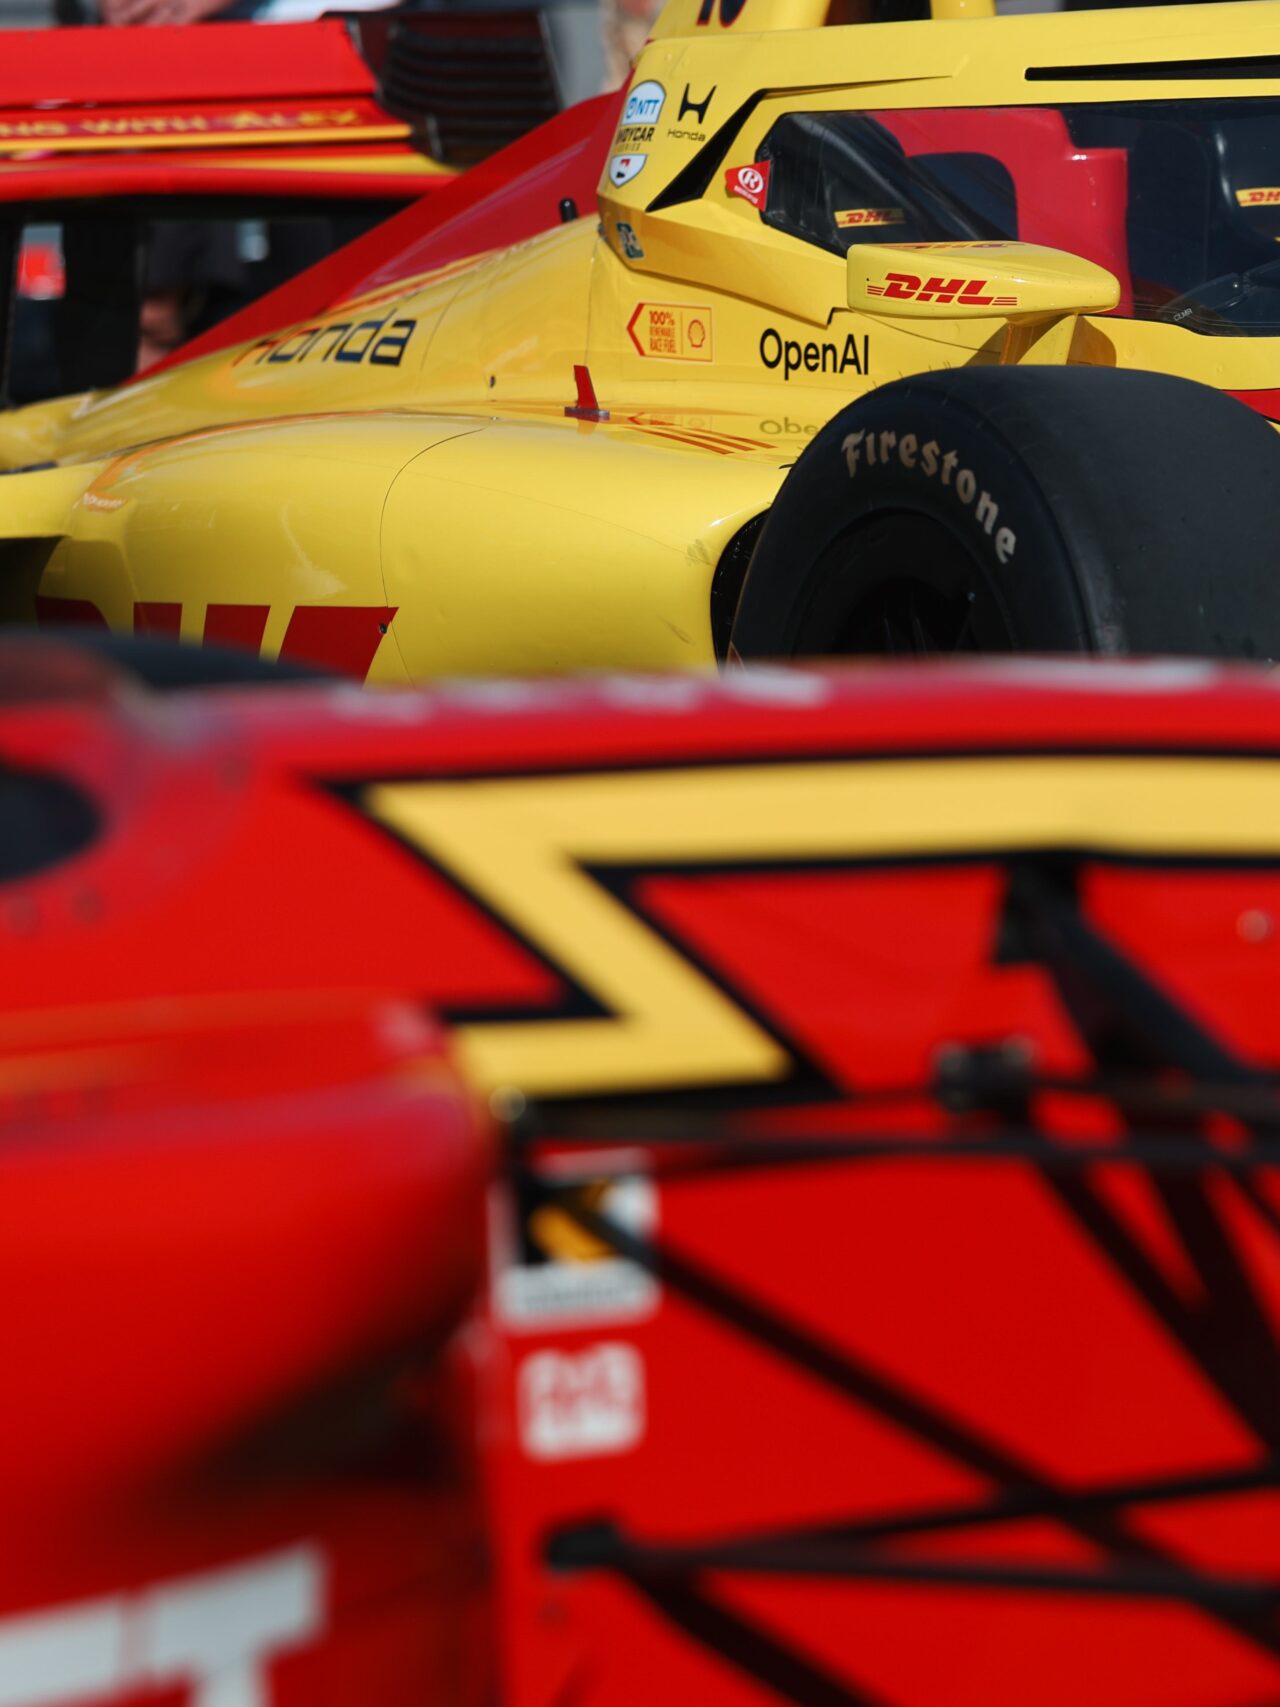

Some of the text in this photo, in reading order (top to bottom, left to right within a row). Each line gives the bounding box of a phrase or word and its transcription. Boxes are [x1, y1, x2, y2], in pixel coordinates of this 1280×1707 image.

[637, 98, 660, 115] NTT
[79, 116, 207, 134] WITH
[667, 128, 706, 142] Honda
[845, 211, 895, 225] DHL
[883, 272, 995, 306] DHL
[648, 310, 676, 326] 100%
[759, 327, 869, 381] OpenAI
[841, 428, 1016, 565] Firestone
